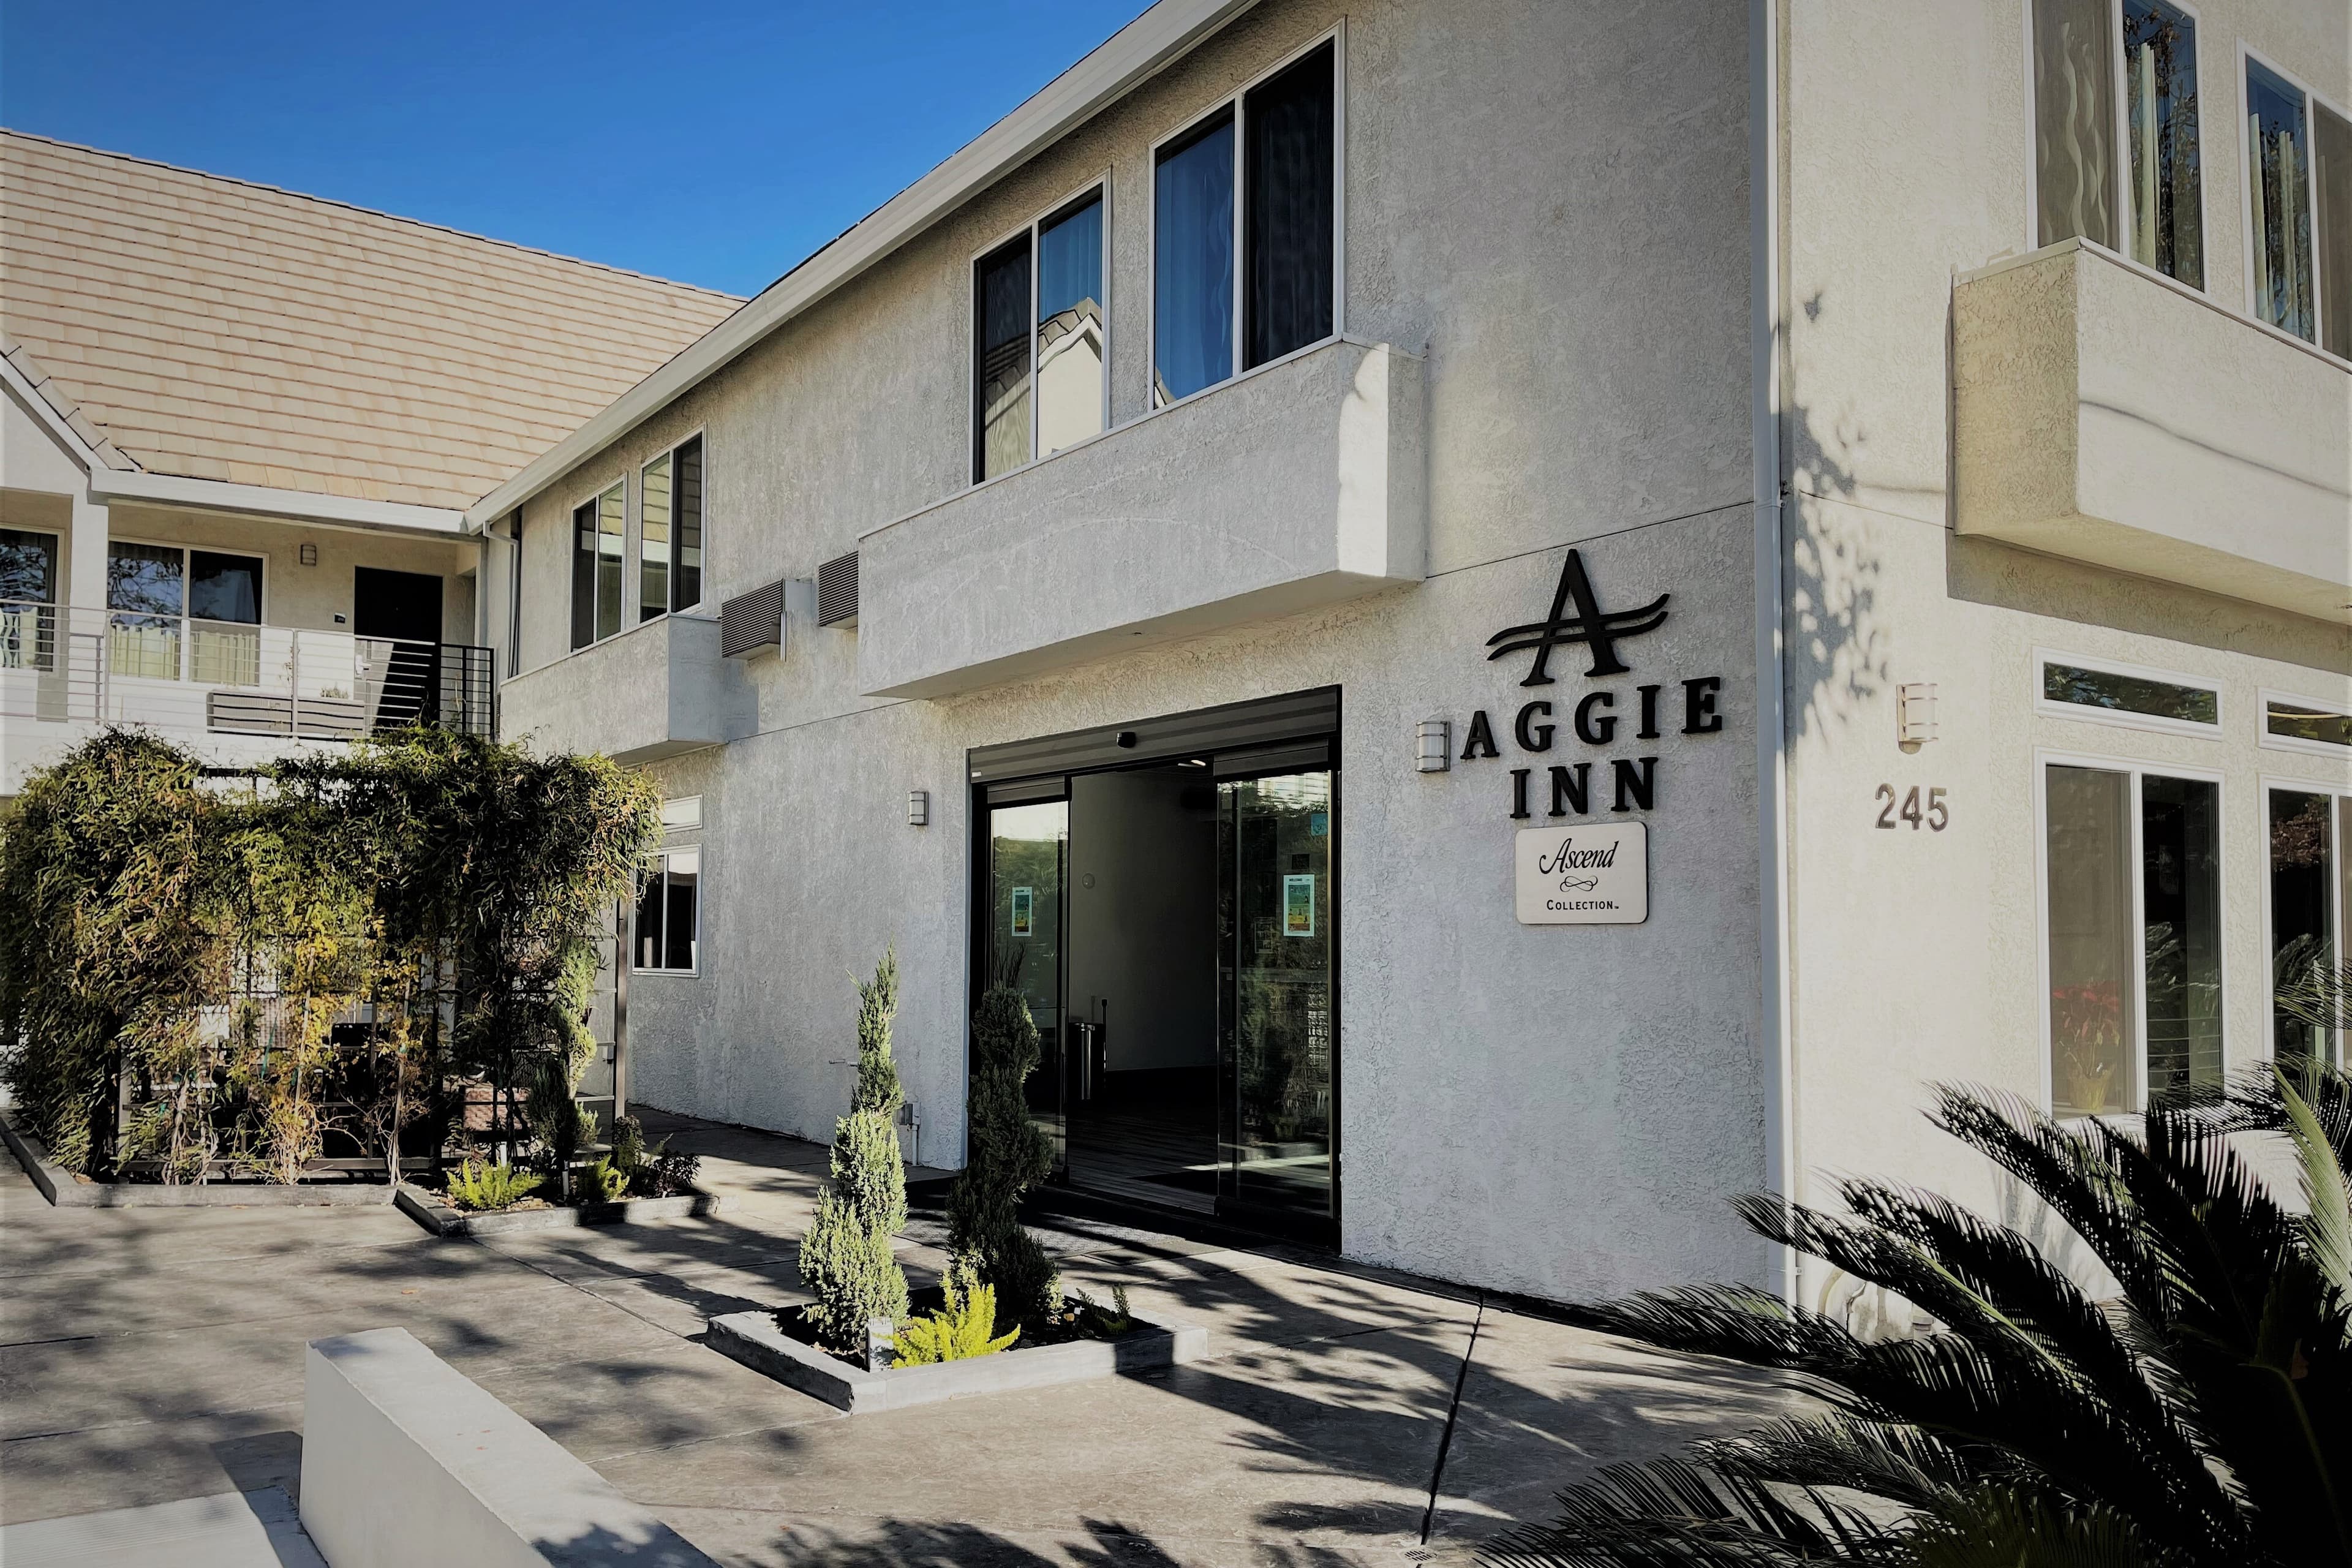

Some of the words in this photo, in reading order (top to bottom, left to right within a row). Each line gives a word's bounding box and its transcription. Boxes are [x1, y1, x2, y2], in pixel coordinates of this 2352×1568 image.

[1485, 548, 1670, 687] A
[1460, 676, 1722, 760] AGGIE
[1510, 756, 1659, 819] INN
[1875, 783, 1949, 832] 245
[1539, 837, 1619, 875] Ascend
